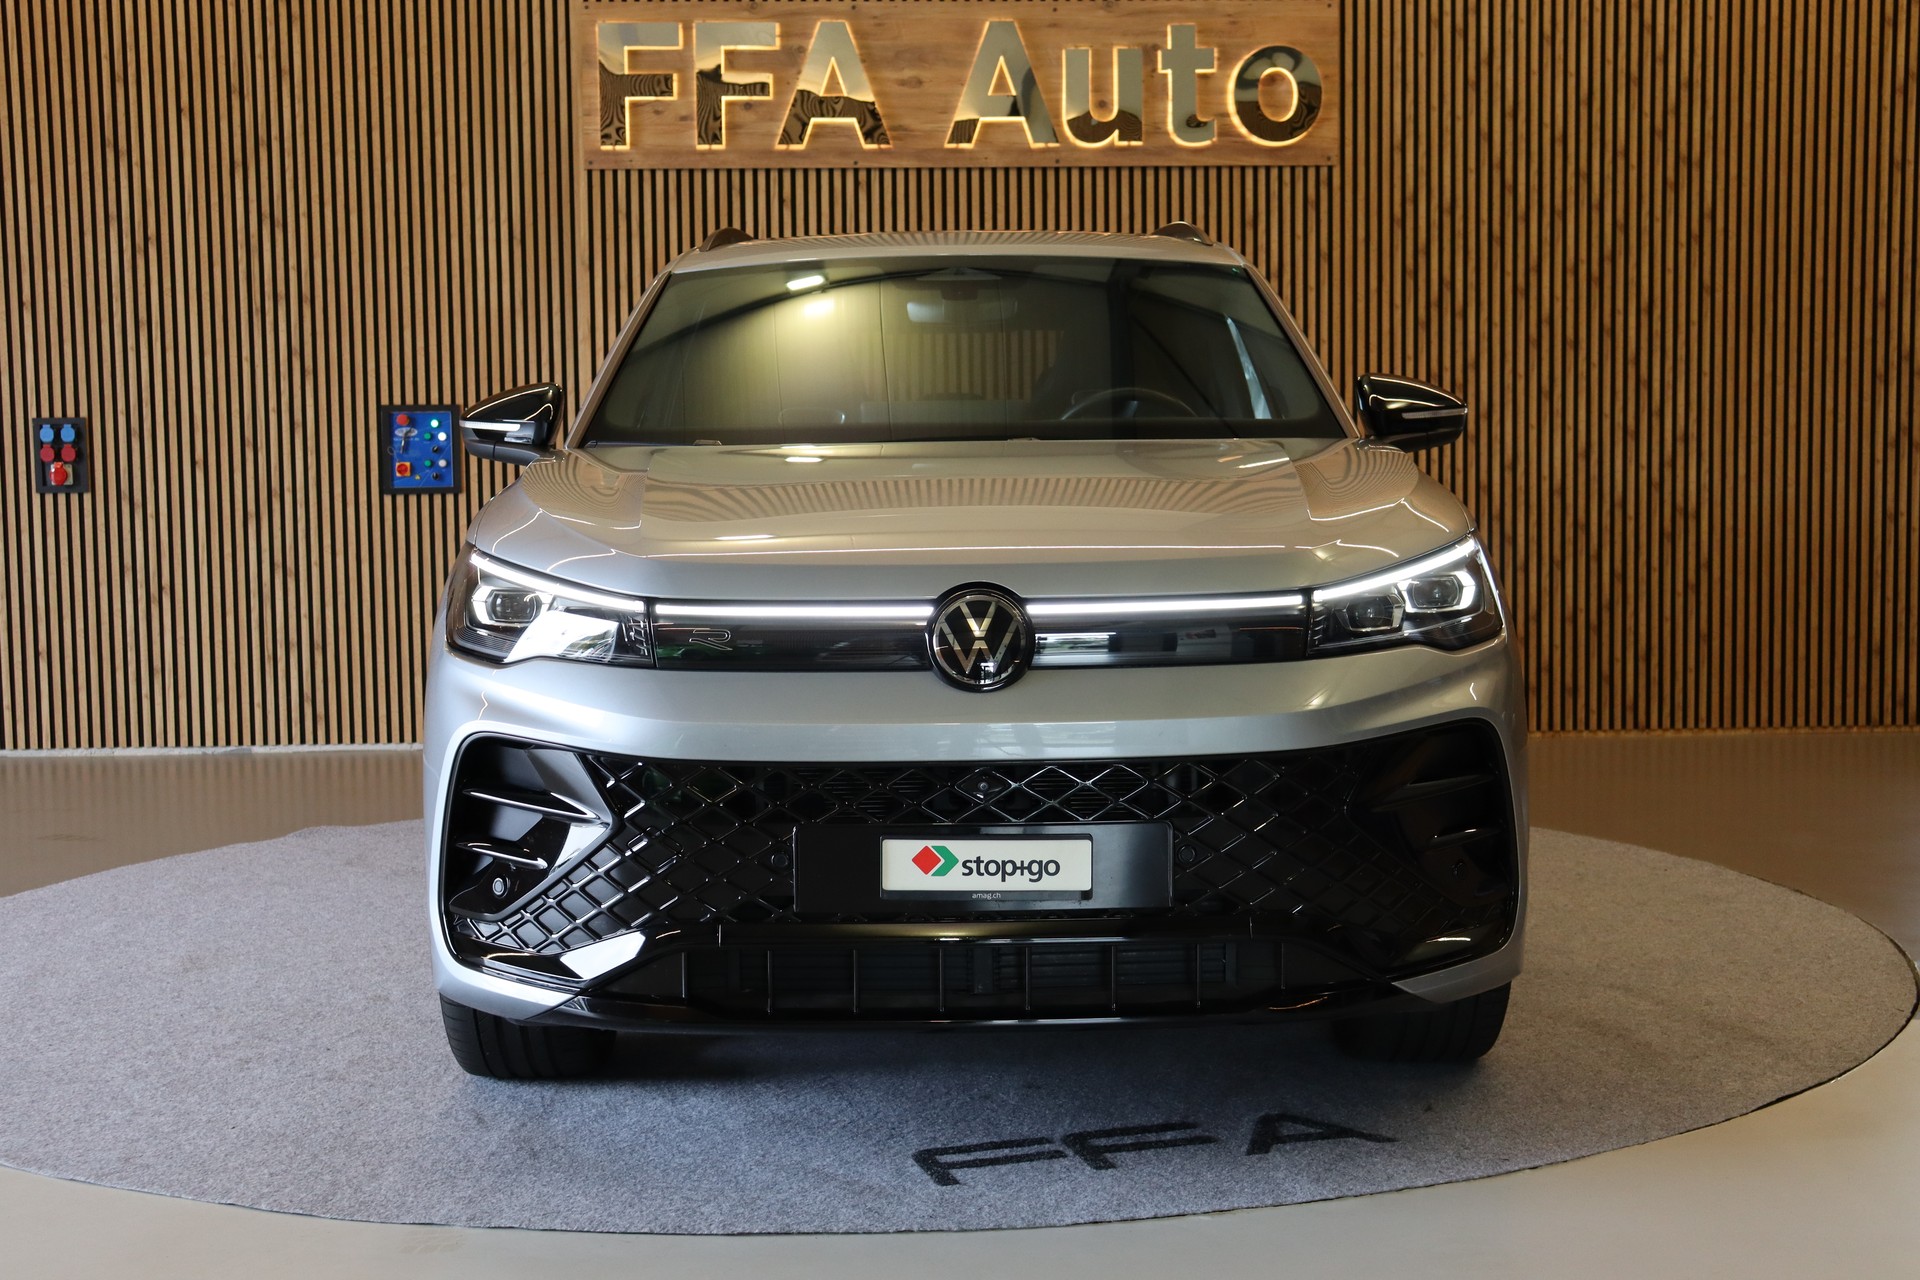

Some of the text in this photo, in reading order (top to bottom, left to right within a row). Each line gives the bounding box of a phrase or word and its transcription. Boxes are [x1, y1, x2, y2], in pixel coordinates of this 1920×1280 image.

[596, 20, 1322, 149] FFA Auto
[689, 628, 734, 650] R
[937, 595, 1023, 681] VW
[961, 856, 1060, 882] stop+go
[972, 892, 1001, 900] amag.ch
[912, 1112, 1399, 1186] FFA
